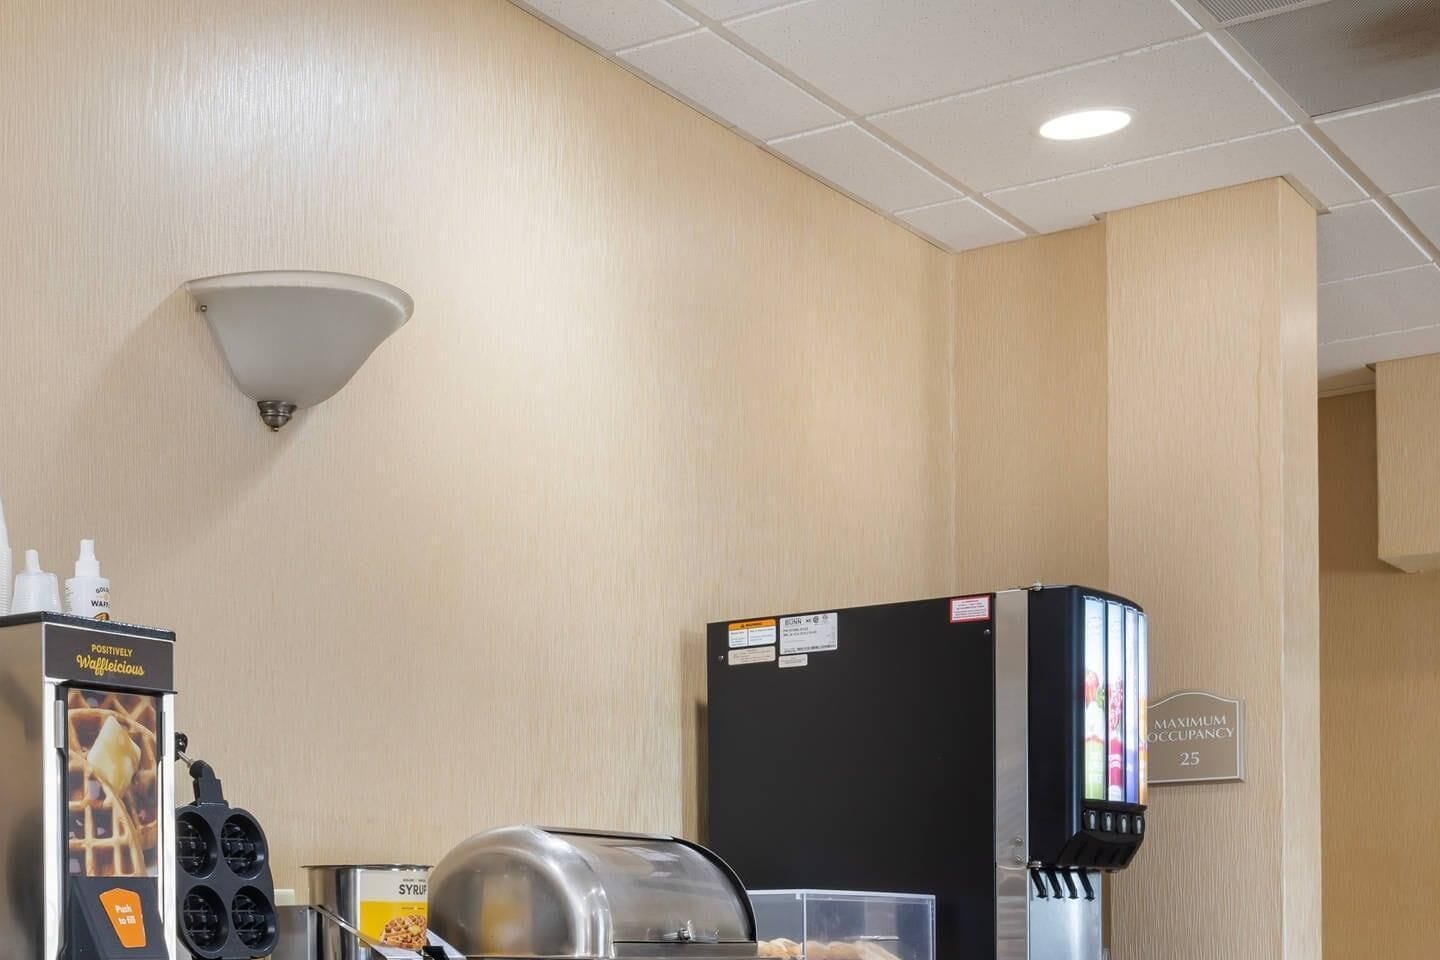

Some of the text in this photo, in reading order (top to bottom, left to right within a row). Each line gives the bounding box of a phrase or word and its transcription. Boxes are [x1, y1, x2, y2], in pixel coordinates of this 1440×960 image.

[91, 644, 134, 657] POSITIVELY
[1154, 715, 1227, 729] MAXIMUM
[1147, 727, 1235, 743] OCCUPANCY
[1179, 752, 1200, 766] 25
[115, 904, 132, 913] Push
